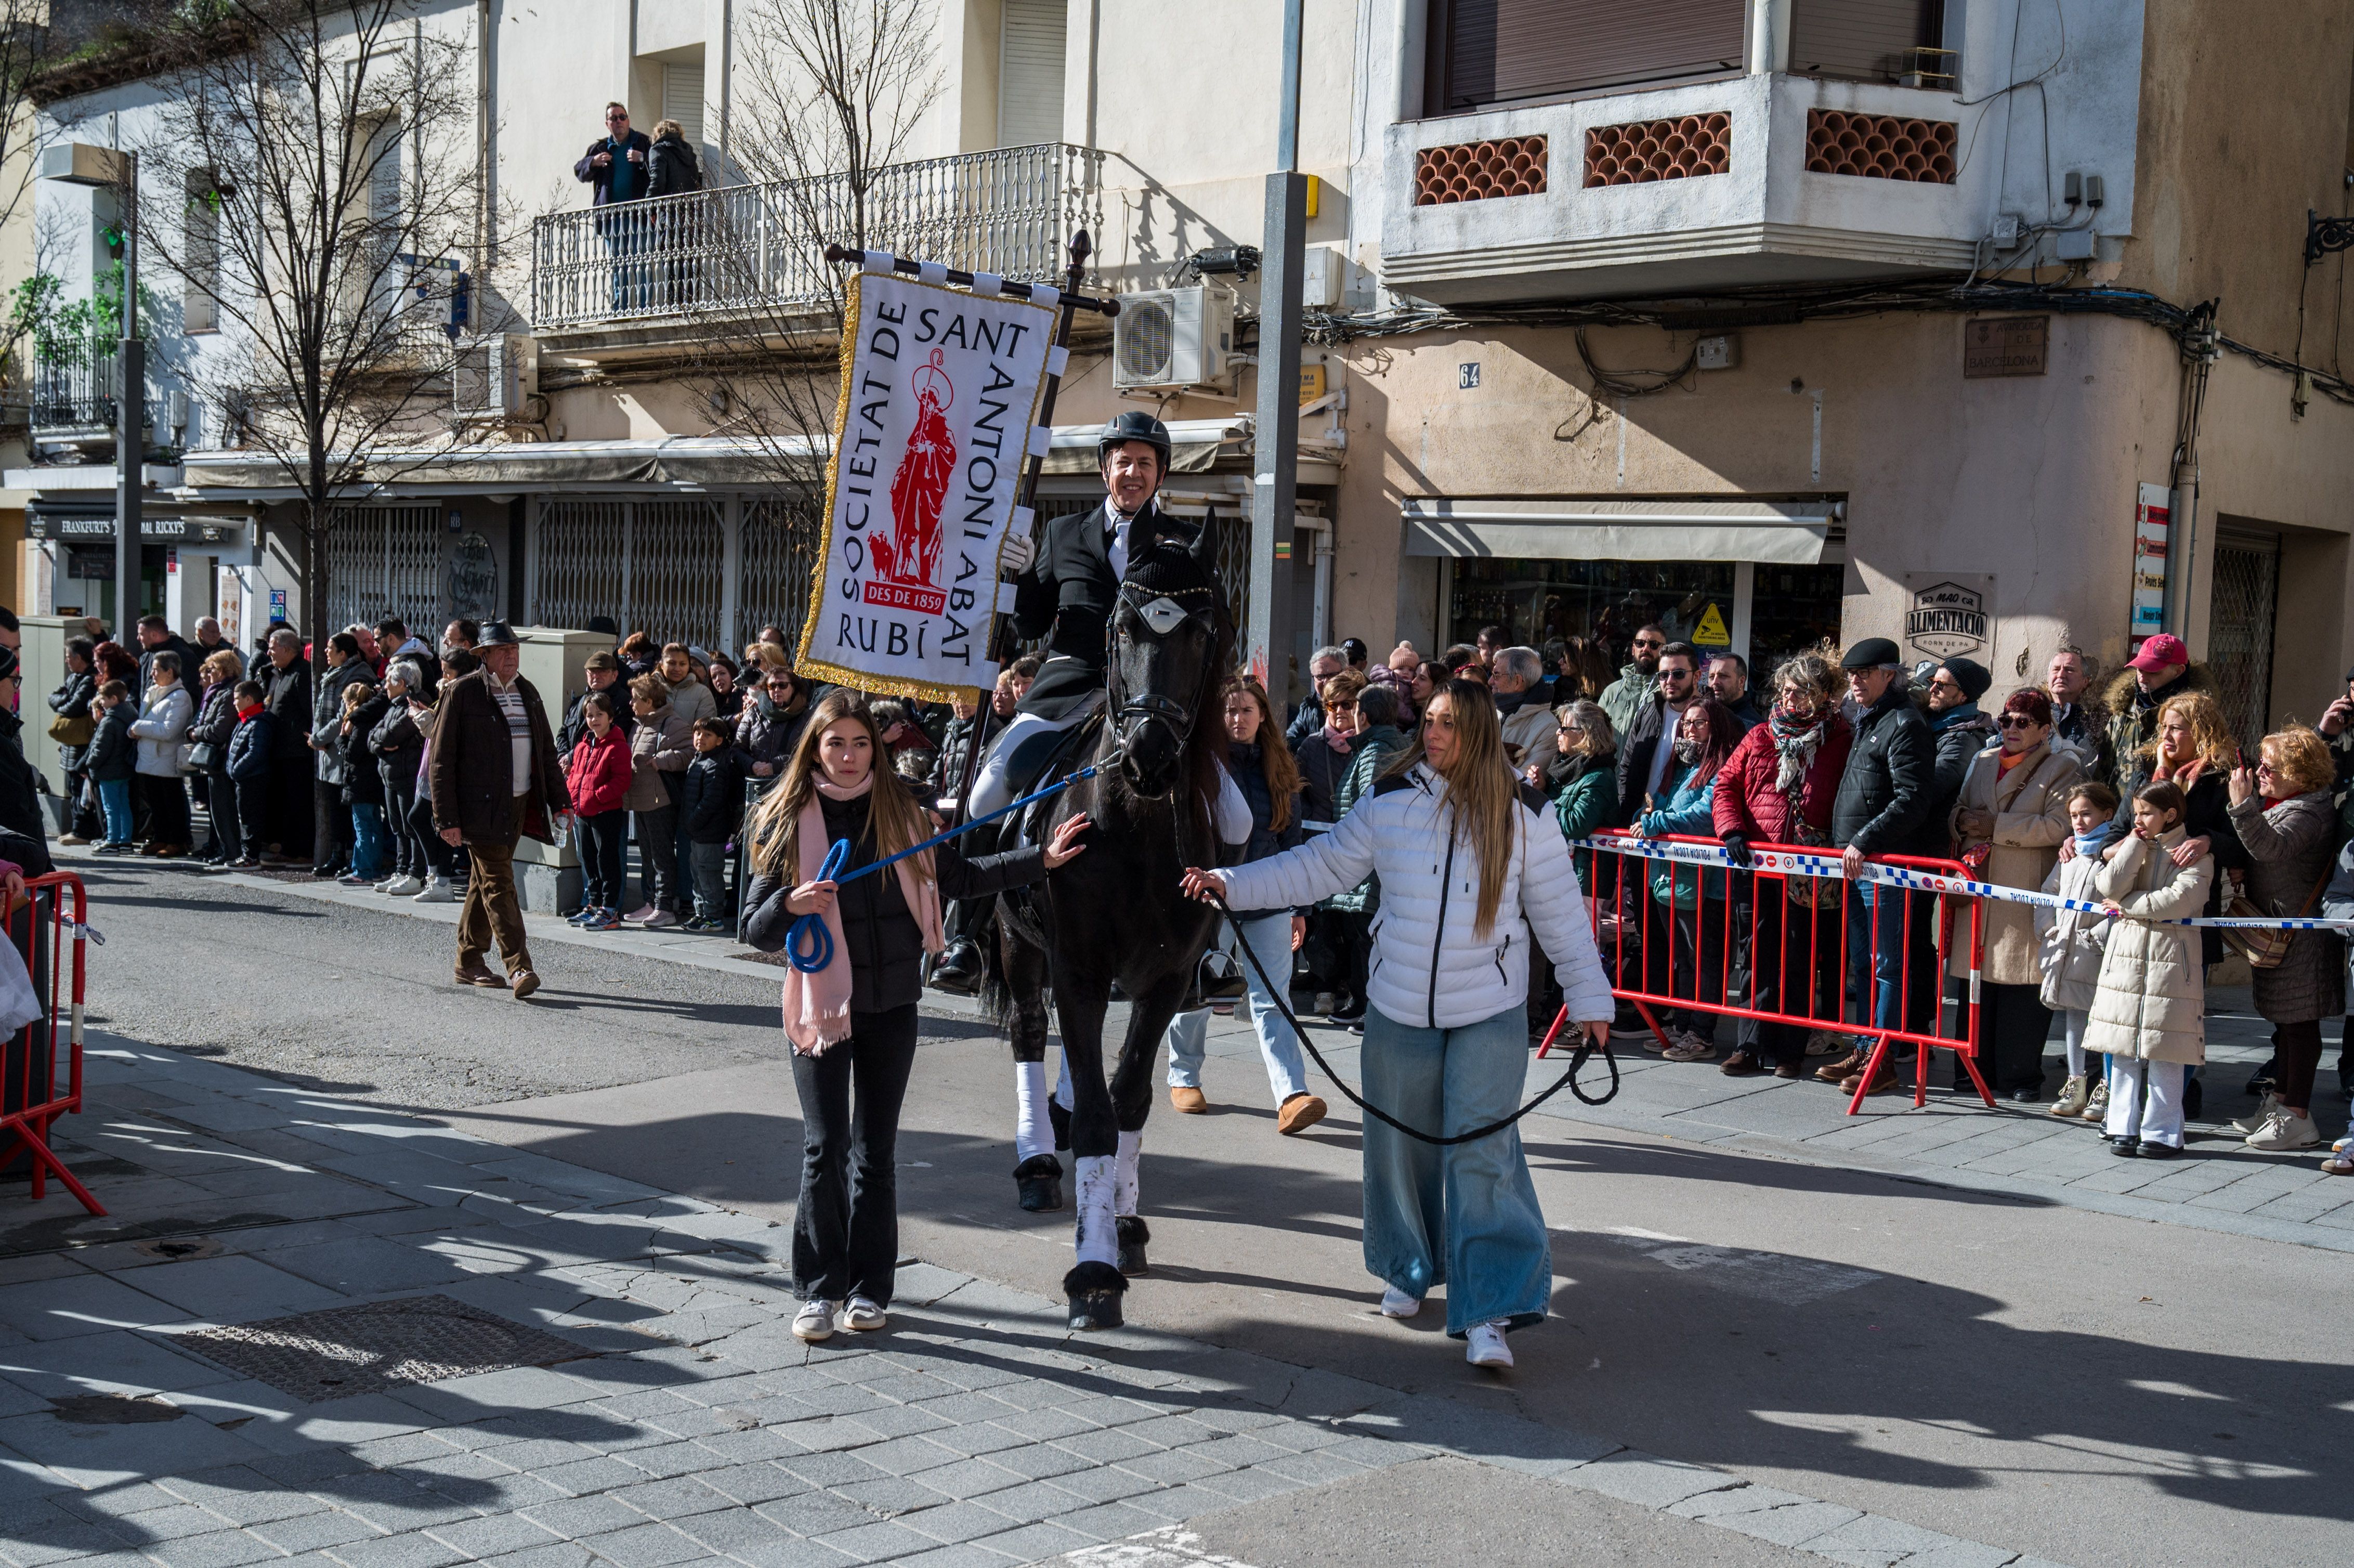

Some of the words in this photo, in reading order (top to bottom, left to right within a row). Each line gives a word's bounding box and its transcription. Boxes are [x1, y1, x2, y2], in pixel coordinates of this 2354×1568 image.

[914, 308, 1029, 359] SANT
[1996, 322, 2044, 333] AVINGUDA
[2017, 335, 2032, 344] DE
[1969, 355, 2038, 368] BARCELONA
[1460, 364, 1479, 387] 64
[841, 370, 893, 603] SOCIETAT
[870, 301, 907, 363] DE
[958, 362, 1015, 543] ANTONI
[61, 520, 111, 533] FRANKFURT'S
[155, 521, 185, 534] RICKY'S
[450, 516, 460, 527] RB
[2145, 576, 2157, 588] Fruits
[868, 585, 892, 603] DES
[894, 589, 911, 605] DE
[913, 592, 943, 611] 1859
[940, 555, 979, 667] ABAT
[1907, 610, 1986, 637] ALIMENTACIÓ
[836, 612, 927, 660] RUBÍ
[1673, 846, 1689, 858] LOCAL
[1690, 848, 1710, 861] POLICIA
